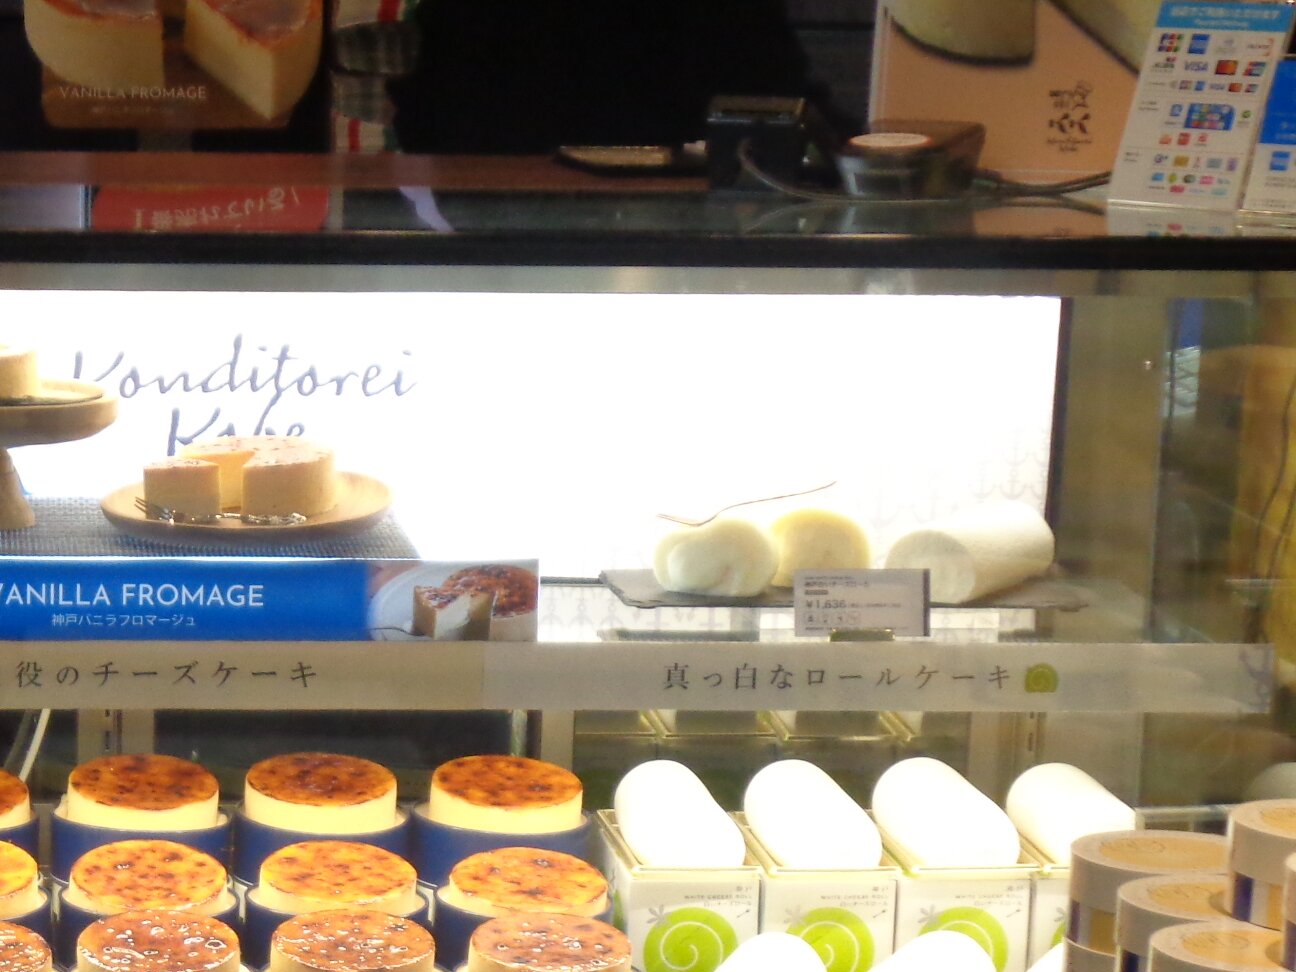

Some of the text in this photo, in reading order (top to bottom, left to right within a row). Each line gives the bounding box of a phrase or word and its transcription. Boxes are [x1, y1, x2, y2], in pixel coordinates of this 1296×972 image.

[122, 584, 264, 607] FROMAGE
[51, 613, 196, 627] 神戸バニラフロマージュ
[663, 662, 1011, 690] 真っ白なロールケーキ
